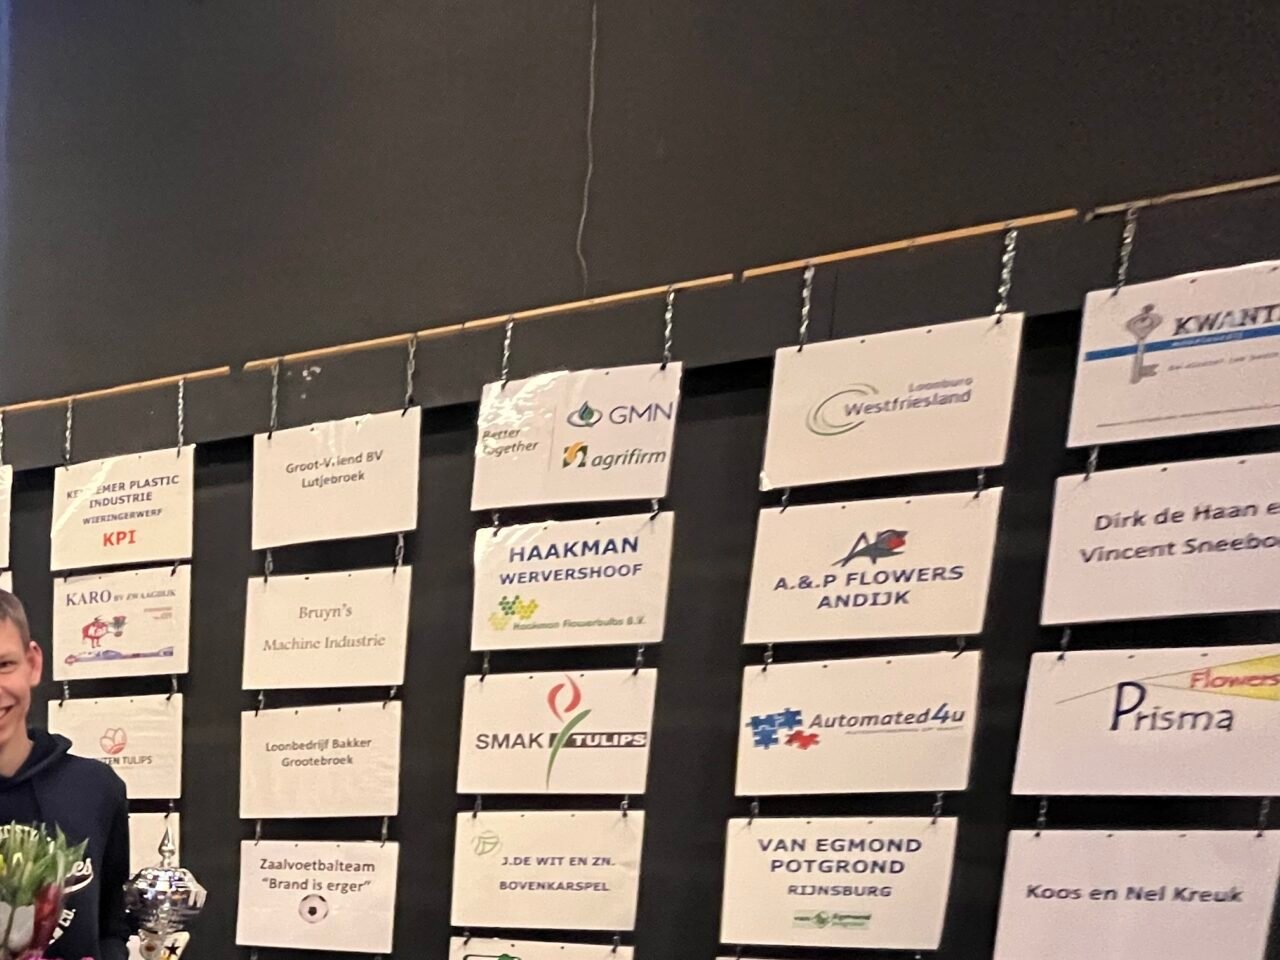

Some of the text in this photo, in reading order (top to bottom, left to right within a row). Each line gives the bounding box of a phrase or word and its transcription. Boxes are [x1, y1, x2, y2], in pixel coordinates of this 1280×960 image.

[844, 388, 973, 417] Westfriesland
[609, 401, 674, 426] GMN
[286, 450, 384, 474] Groot-Viend BV
[591, 447, 666, 470] agrifirm
[66, 475, 180, 499] KEEMER PLASTIC
[301, 470, 365, 489] Lutjebroek
[89, 492, 153, 509] INDUSTRIE
[82, 508, 162, 525] WIERINGERWERF
[1094, 509, 1146, 531] Dirk
[1153, 507, 1185, 525] de
[1192, 502, 1258, 521] Haan
[103, 530, 137, 547] KPI
[509, 536, 639, 563] HAAKMAN
[1079, 541, 1176, 563] Vincent
[500, 563, 643, 585] WERVERSHOOF
[845, 565, 965, 587] FLOWERS
[66, 589, 112, 607] KARO
[816, 590, 910, 609] ANDIJK
[298, 604, 353, 622] Bruyn's
[263, 635, 386, 651] Machine Industrie
[1190, 668, 1280, 689] Flowers
[1109, 680, 1235, 732] Prisma
[808, 703, 966, 730] Automated4u
[266, 738, 372, 752] Loonbedrijf Bakker
[475, 732, 647, 749] SMAK TULIPS
[281, 755, 353, 767] Grootebroek
[758, 838, 923, 853] VAN EGMOND
[259, 858, 376, 873] Zaalvoetbalteam
[536, 857, 565, 866] WIT
[569, 857, 588, 866] EN
[592, 857, 616, 866] ZN.
[770, 859, 905, 874] POTGROND
[312, 879, 323, 891] is
[499, 881, 610, 892] BOVENKARSPEL
[787, 885, 892, 897] RIJNSBURG
[1026, 884, 1243, 903] Koos en Nel Kreuk
